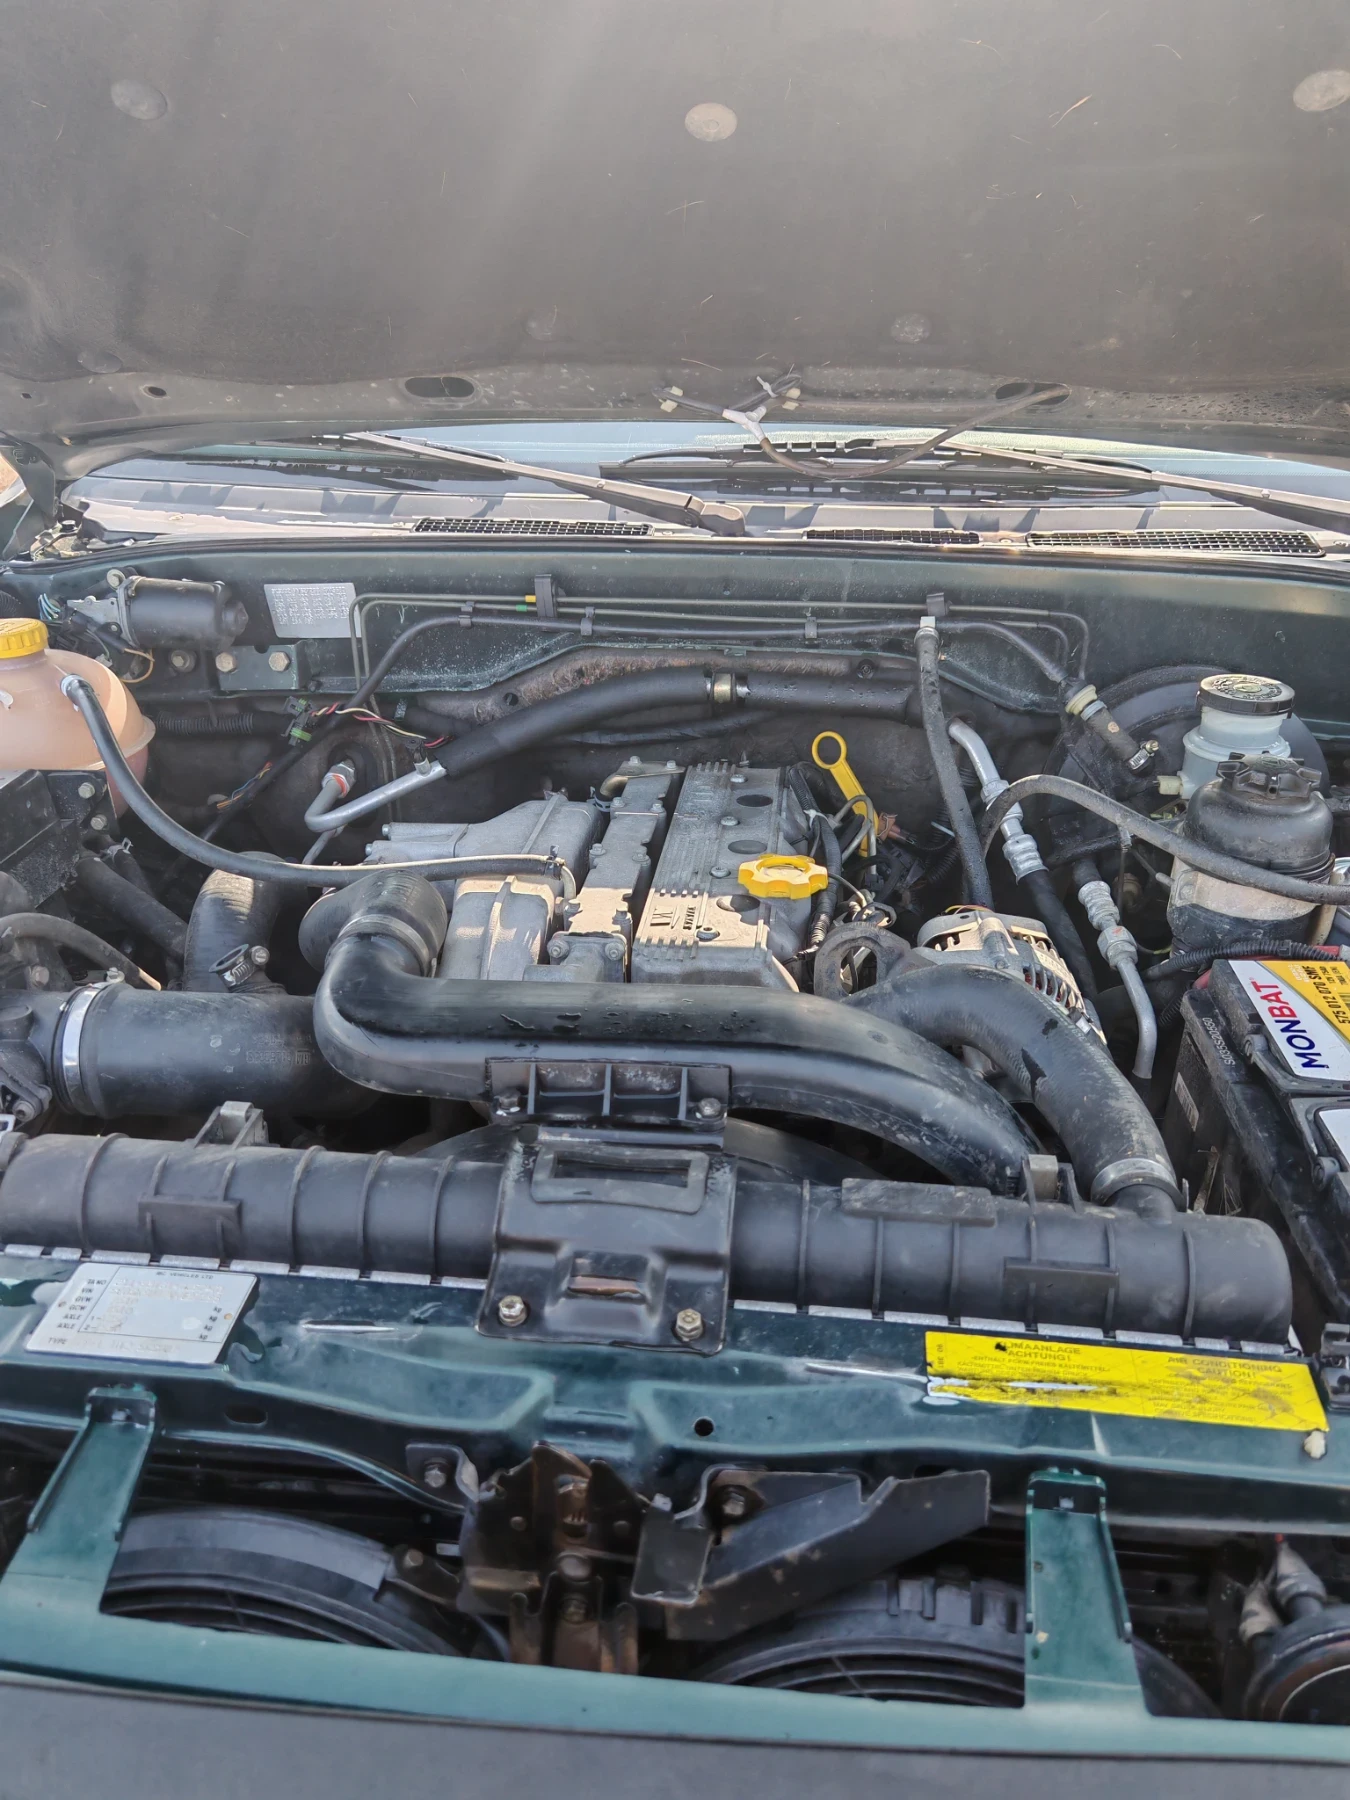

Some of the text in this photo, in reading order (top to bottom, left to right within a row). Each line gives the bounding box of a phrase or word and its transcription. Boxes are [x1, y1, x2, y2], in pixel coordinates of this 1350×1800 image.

[1302, 966, 1350, 1024] 575 012 070 SMF
[1251, 981, 1329, 1069] MONBAT
[999, 1341, 1081, 1355] LIMAANLAGE
[1007, 1349, 1071, 1362] ACHTUNG!
[1167, 1356, 1282, 1373] AIR CONDITIONING
